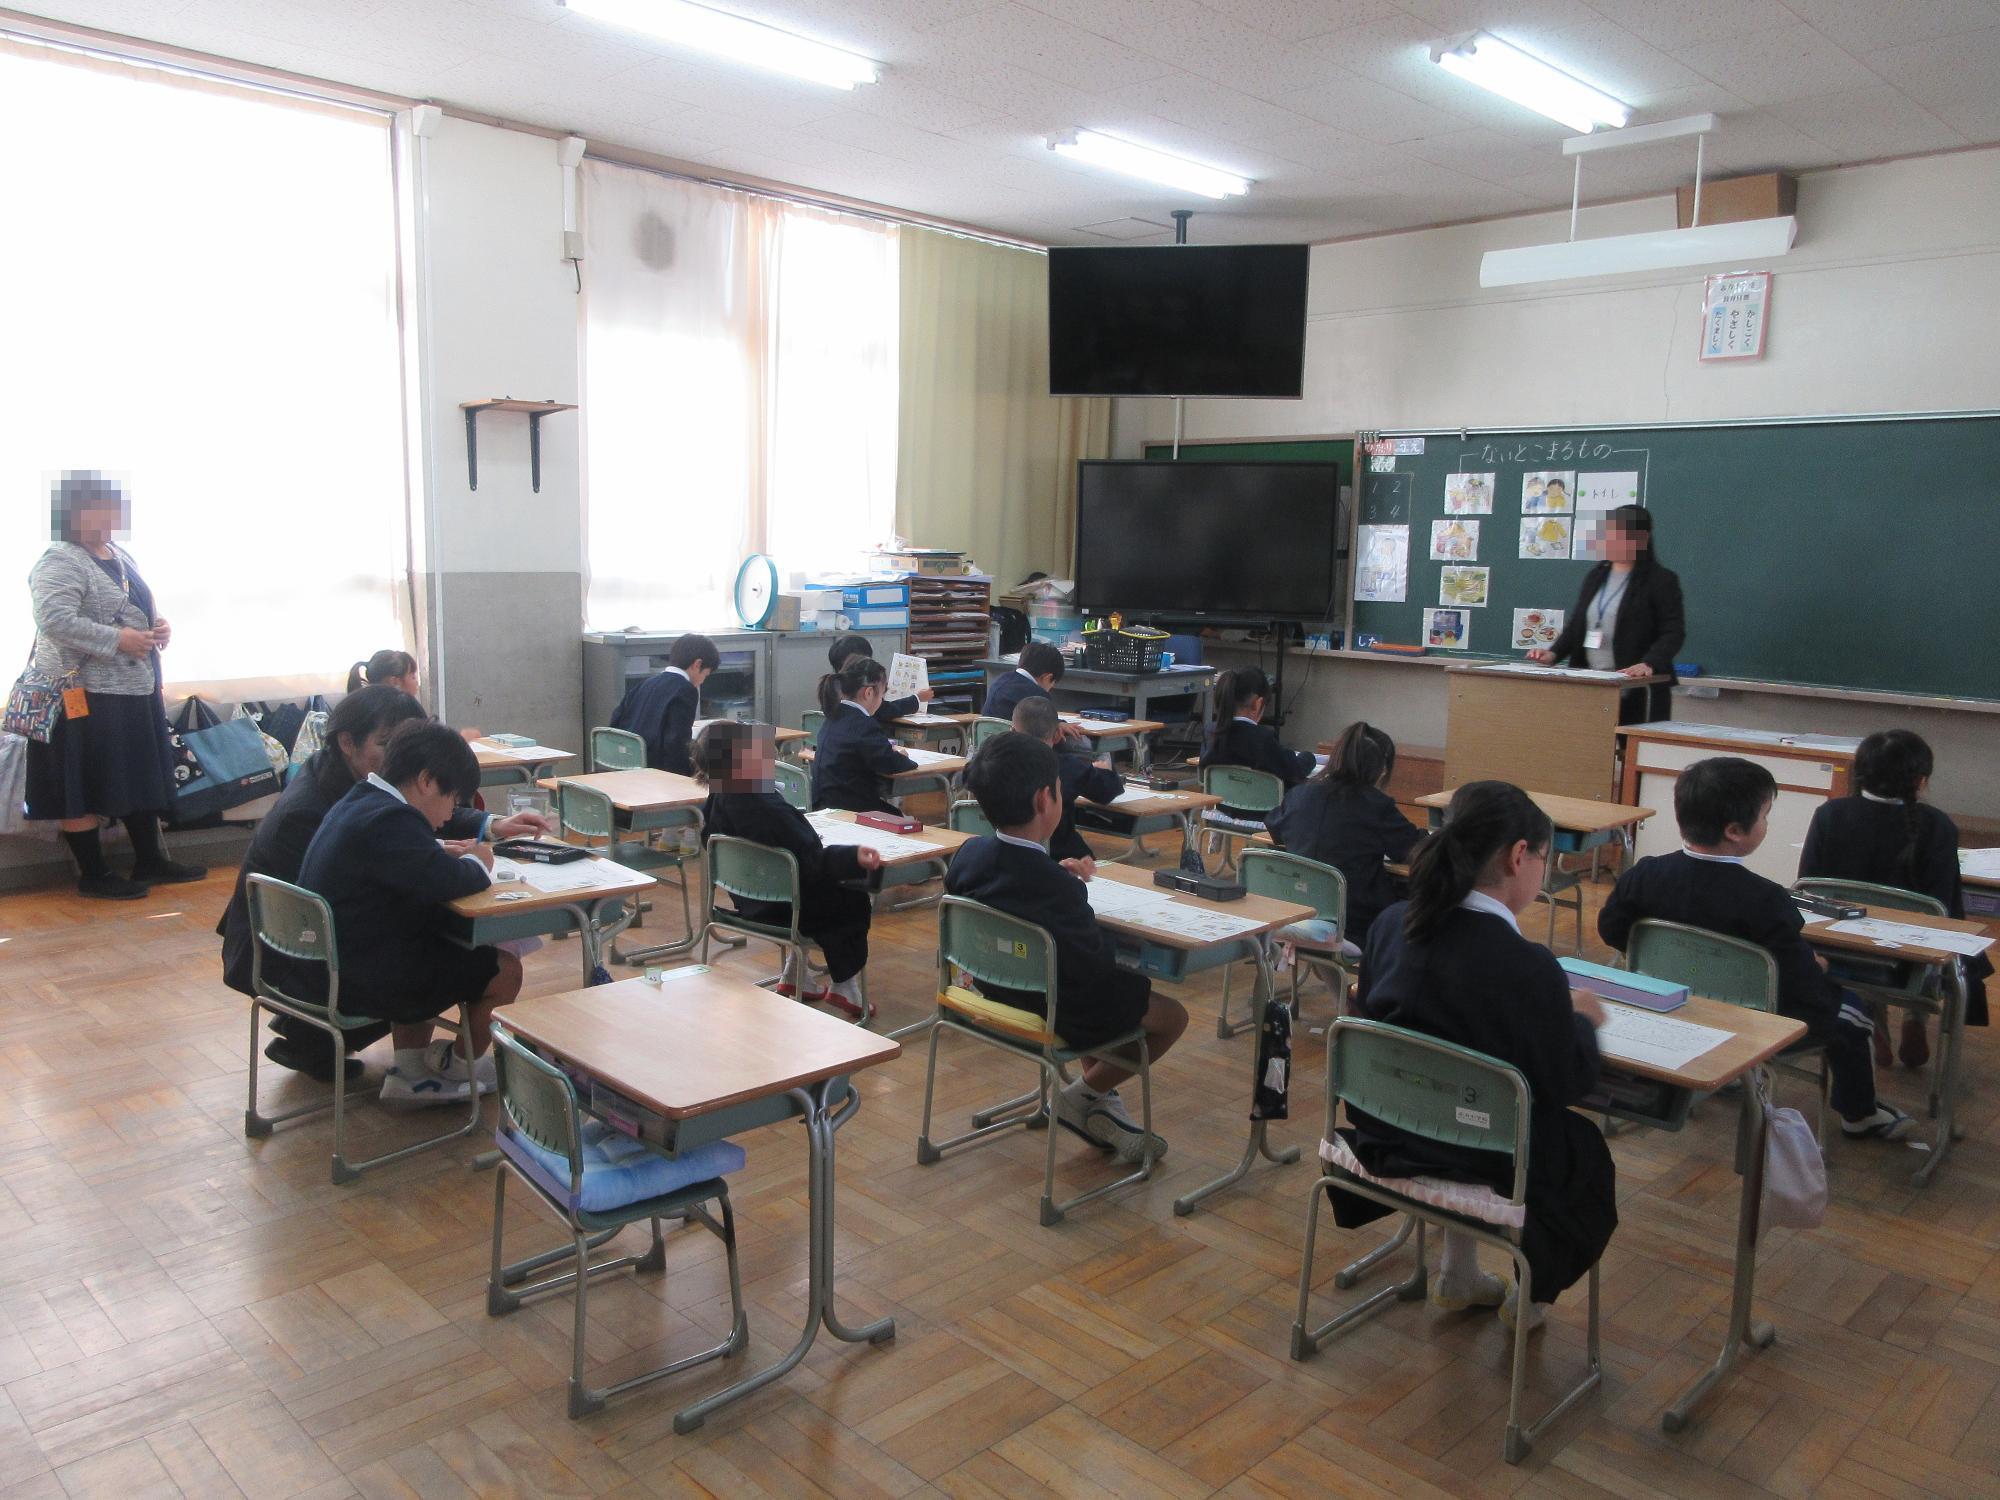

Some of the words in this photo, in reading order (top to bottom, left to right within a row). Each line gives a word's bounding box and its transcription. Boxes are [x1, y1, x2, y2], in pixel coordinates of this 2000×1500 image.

[1727, 309, 1740, 350] やさしく
[1743, 309, 1756, 347] かしこく
[1481, 438, 1612, 464] ないとこまるもの
[1372, 482, 1378, 494] 1
[1392, 480, 1401, 493] 2
[1369, 506, 1377, 520] 3
[1390, 504, 1401, 519] 4
[1358, 635, 1378, 647] した
[1017, 943, 1024, 951] 3
[1464, 1086, 1477, 1104] 3
